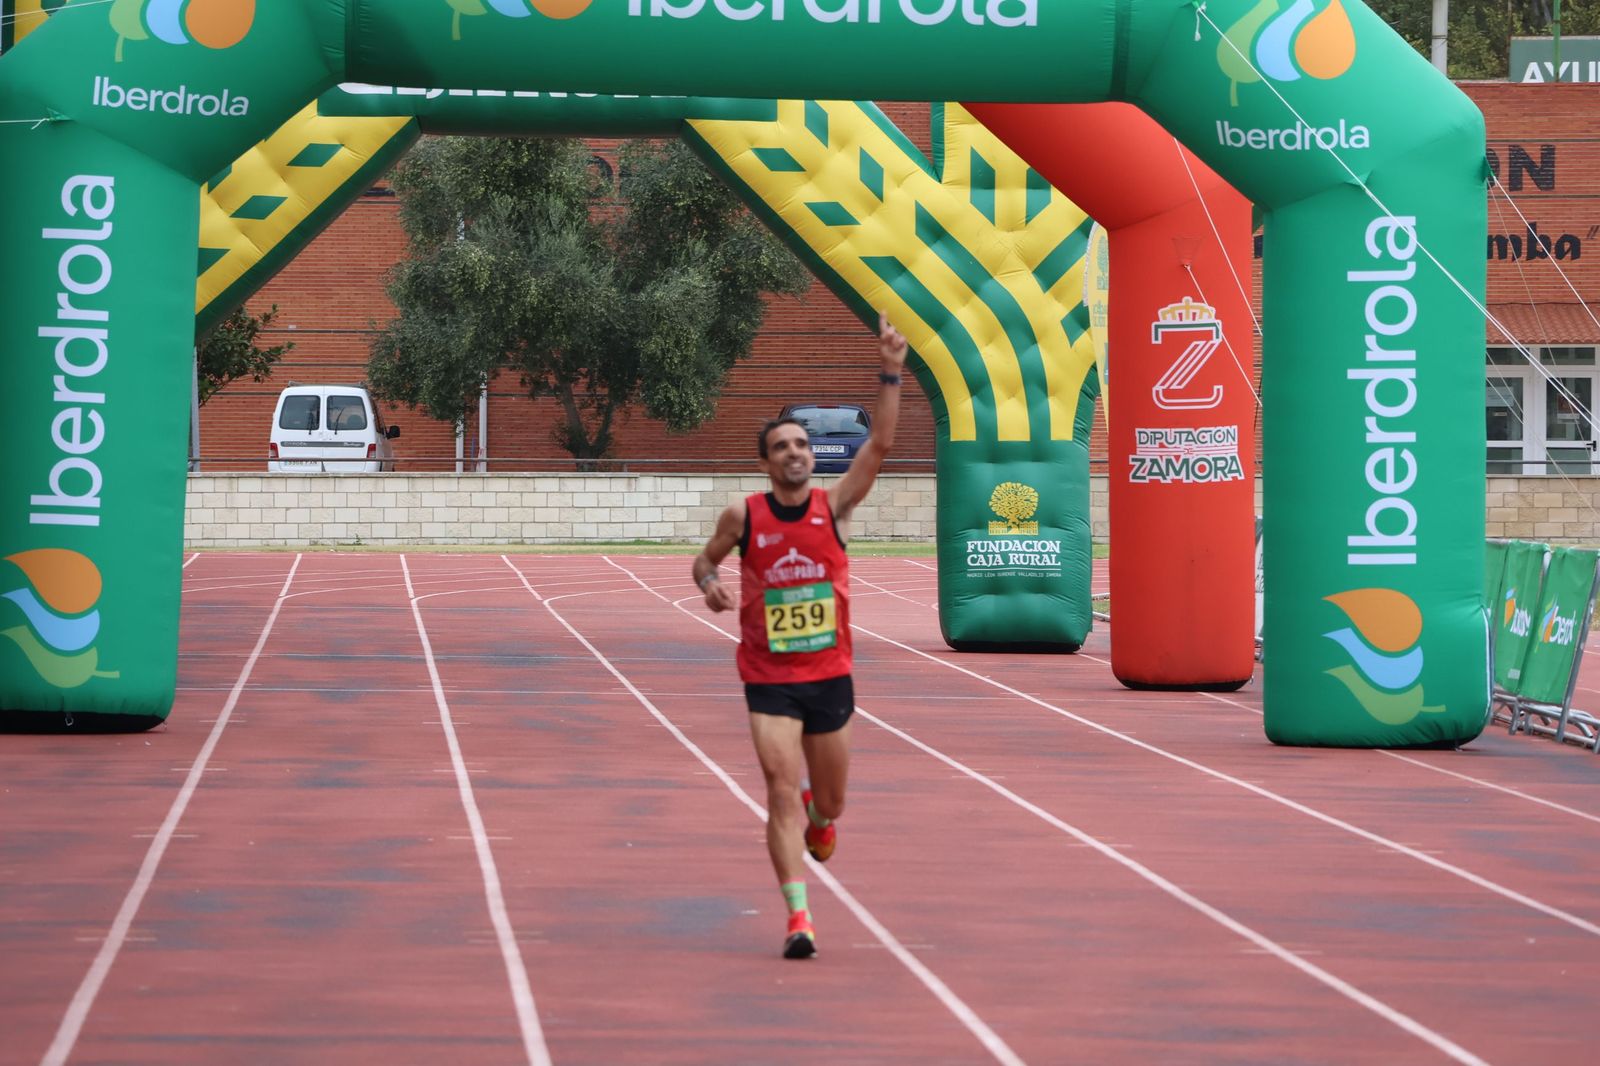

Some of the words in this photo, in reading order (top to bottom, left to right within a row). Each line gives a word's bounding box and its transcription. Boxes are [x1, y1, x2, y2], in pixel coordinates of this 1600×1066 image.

[1522, 61, 1600, 84] AYU
[93, 76, 249, 117] Iberdrola
[1216, 118, 1370, 151] Iberdrola
[29, 174, 115, 526] Iberdrola
[1347, 215, 1418, 565] Iberdrola
[1130, 455, 1243, 480] ZAMORA
[966, 554, 1005, 567] CAJA
[1008, 553, 1062, 566] RURAL
[770, 602, 825, 632] 259
